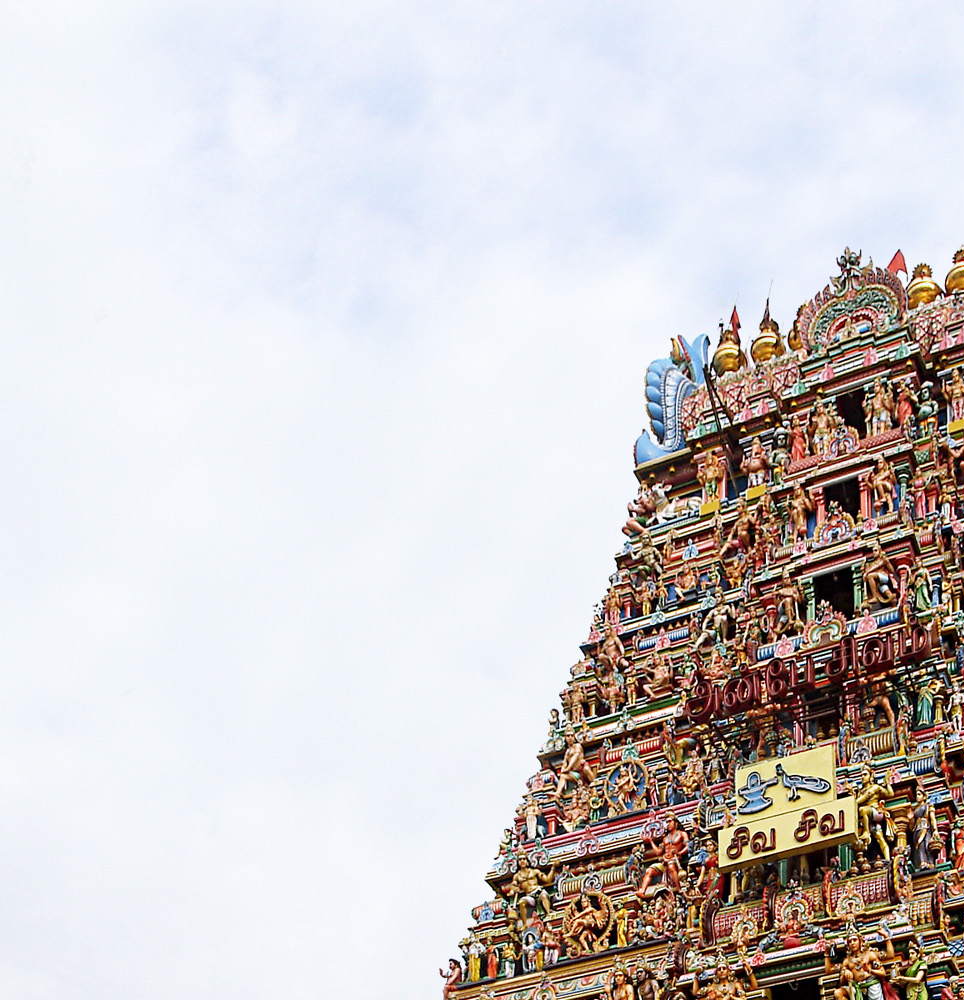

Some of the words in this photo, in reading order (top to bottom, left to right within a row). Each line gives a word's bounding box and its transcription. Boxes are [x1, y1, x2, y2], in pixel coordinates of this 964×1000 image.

[685, 657, 815, 719] அன்பே
[825, 615, 931, 683] சிவம்
[726, 826, 776, 860] சிவ
[793, 808, 845, 842] சிவ
